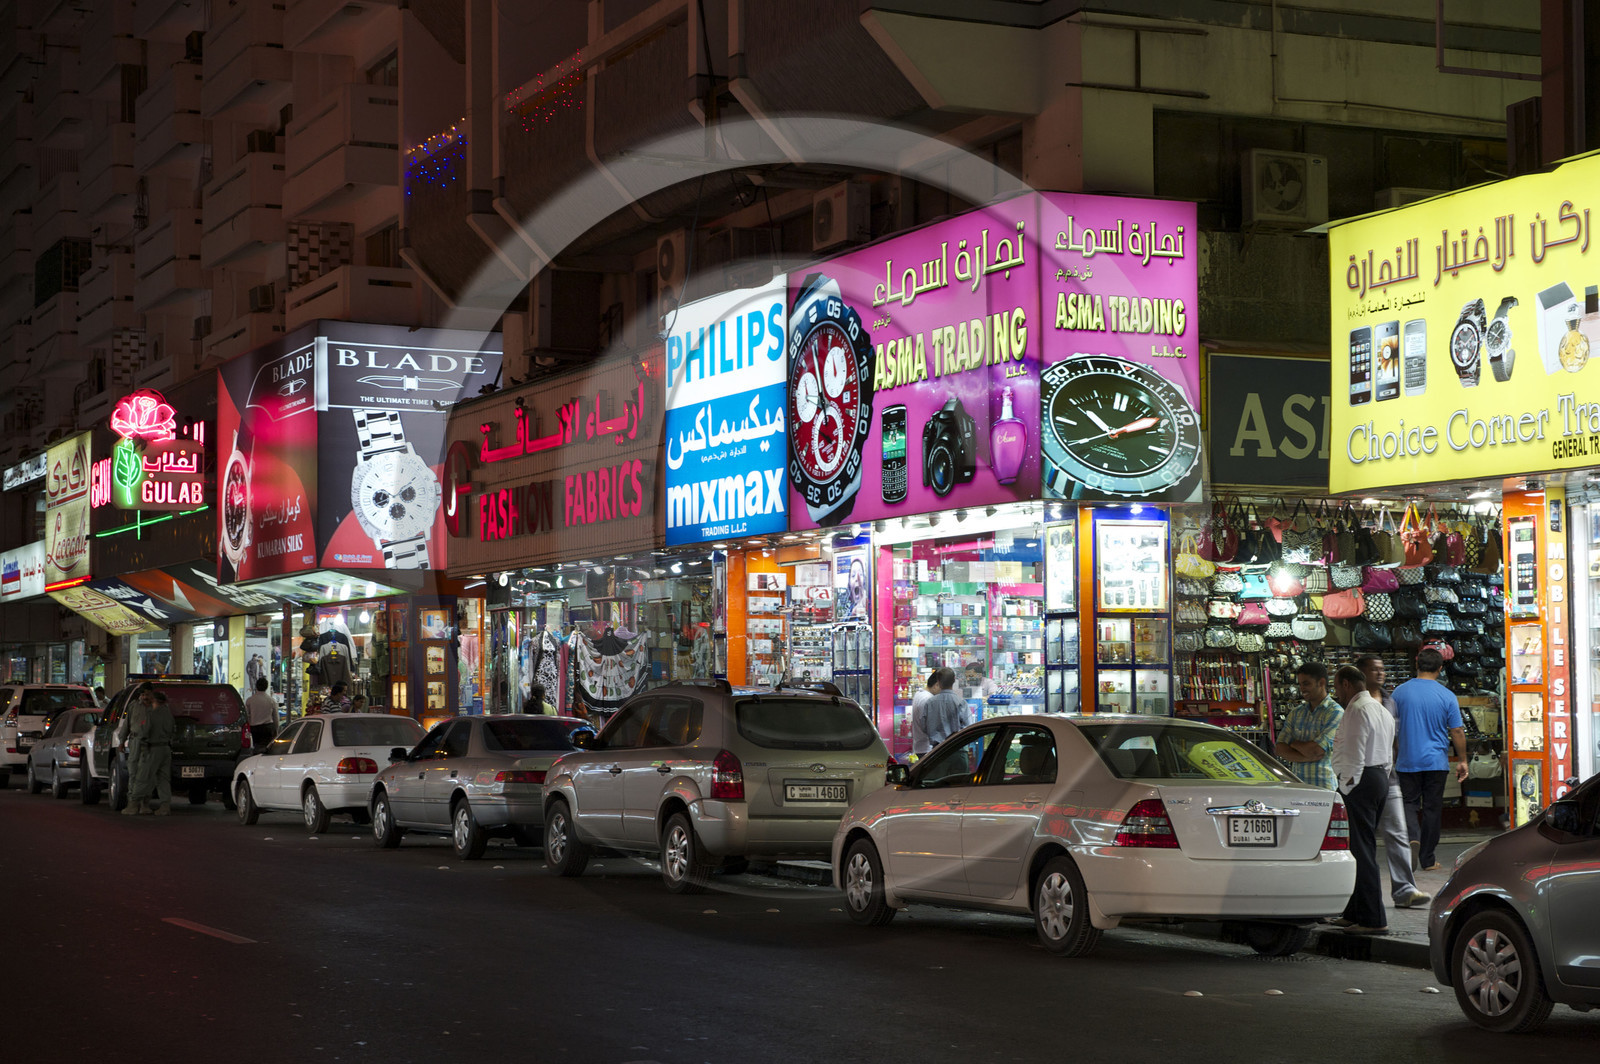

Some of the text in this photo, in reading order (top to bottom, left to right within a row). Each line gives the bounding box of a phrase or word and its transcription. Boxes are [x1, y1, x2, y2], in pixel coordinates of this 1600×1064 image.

[1055, 216, 1185, 267] تجارة اسماء
[1347, 199, 1591, 299] ركن الاختيار للتجارة
[872, 220, 1025, 307] تجارة اسماء
[826, 299, 841, 319] 05
[1055, 292, 1187, 337] ASMA TRADING
[848, 316, 860, 341] 10
[667, 302, 785, 389] PHILIPS
[873, 306, 1028, 392] ASMA TRADING
[272, 352, 313, 383] BLADE
[336, 348, 487, 375] BLADE
[1043, 365, 1070, 385] 50
[359, 395, 375, 403] THE
[376, 396, 410, 405] ULTIMATE
[411, 398, 429, 406] TIME
[1177, 404, 1195, 426] 10
[666, 393, 785, 470] ميكسماكس
[1347, 419, 1438, 464] Choice
[1447, 408, 1549, 451] Corner
[1553, 437, 1588, 460] GENERAL
[142, 480, 203, 504] GULAB
[565, 458, 643, 528] FABRICS
[667, 467, 785, 528] mixmax
[479, 480, 554, 542] FASHION
[701, 524, 730, 538] TRADING
[257, 533, 304, 559] KUMARAN SILKS
[1549, 541, 1566, 667] MOBILE
[790, 787, 796, 798] C
[815, 786, 845, 799] 14608
[1233, 819, 1272, 833] E 21660
